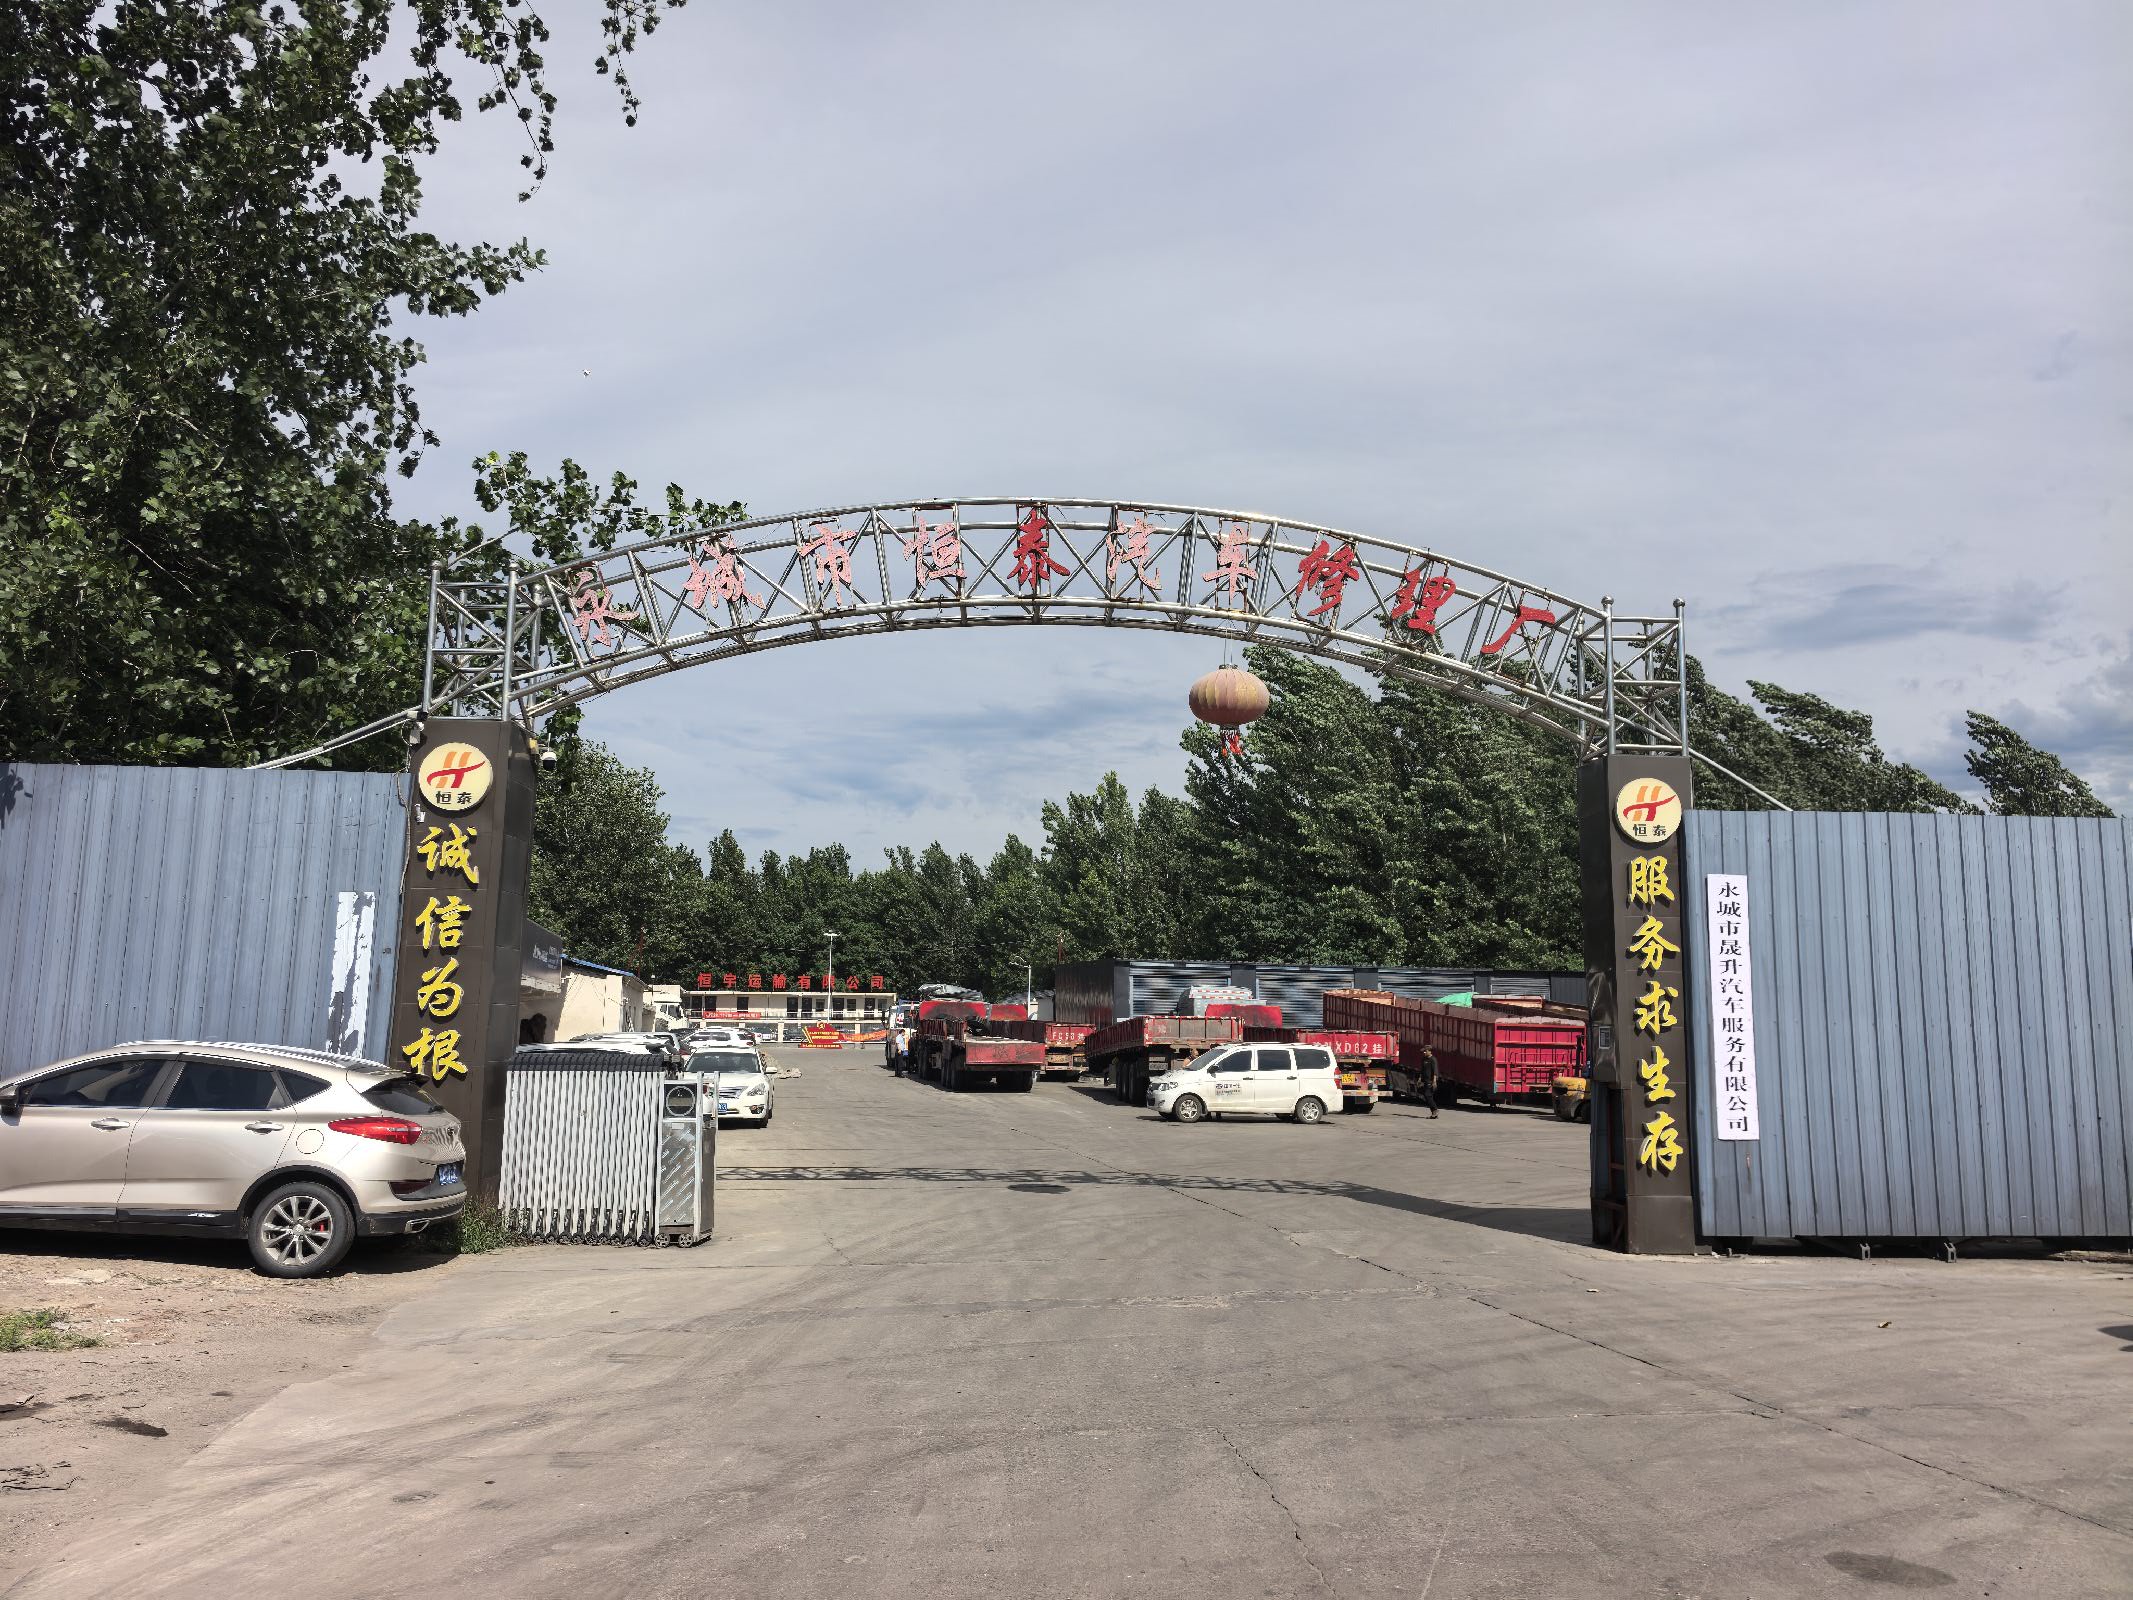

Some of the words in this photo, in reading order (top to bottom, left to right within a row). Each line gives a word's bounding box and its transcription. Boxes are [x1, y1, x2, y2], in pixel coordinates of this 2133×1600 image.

[435, 791, 472, 805] 恒泰
[1632, 823, 1667, 837] 恒泰
[402, 821, 481, 1082] 诚信为根
[697, 972, 885, 990] 恒宇运输有限公司
[1629, 856, 1683, 1171] 服务求生存
[1717, 881, 1749, 1133] 永城市晟升汽车服务有限公司
